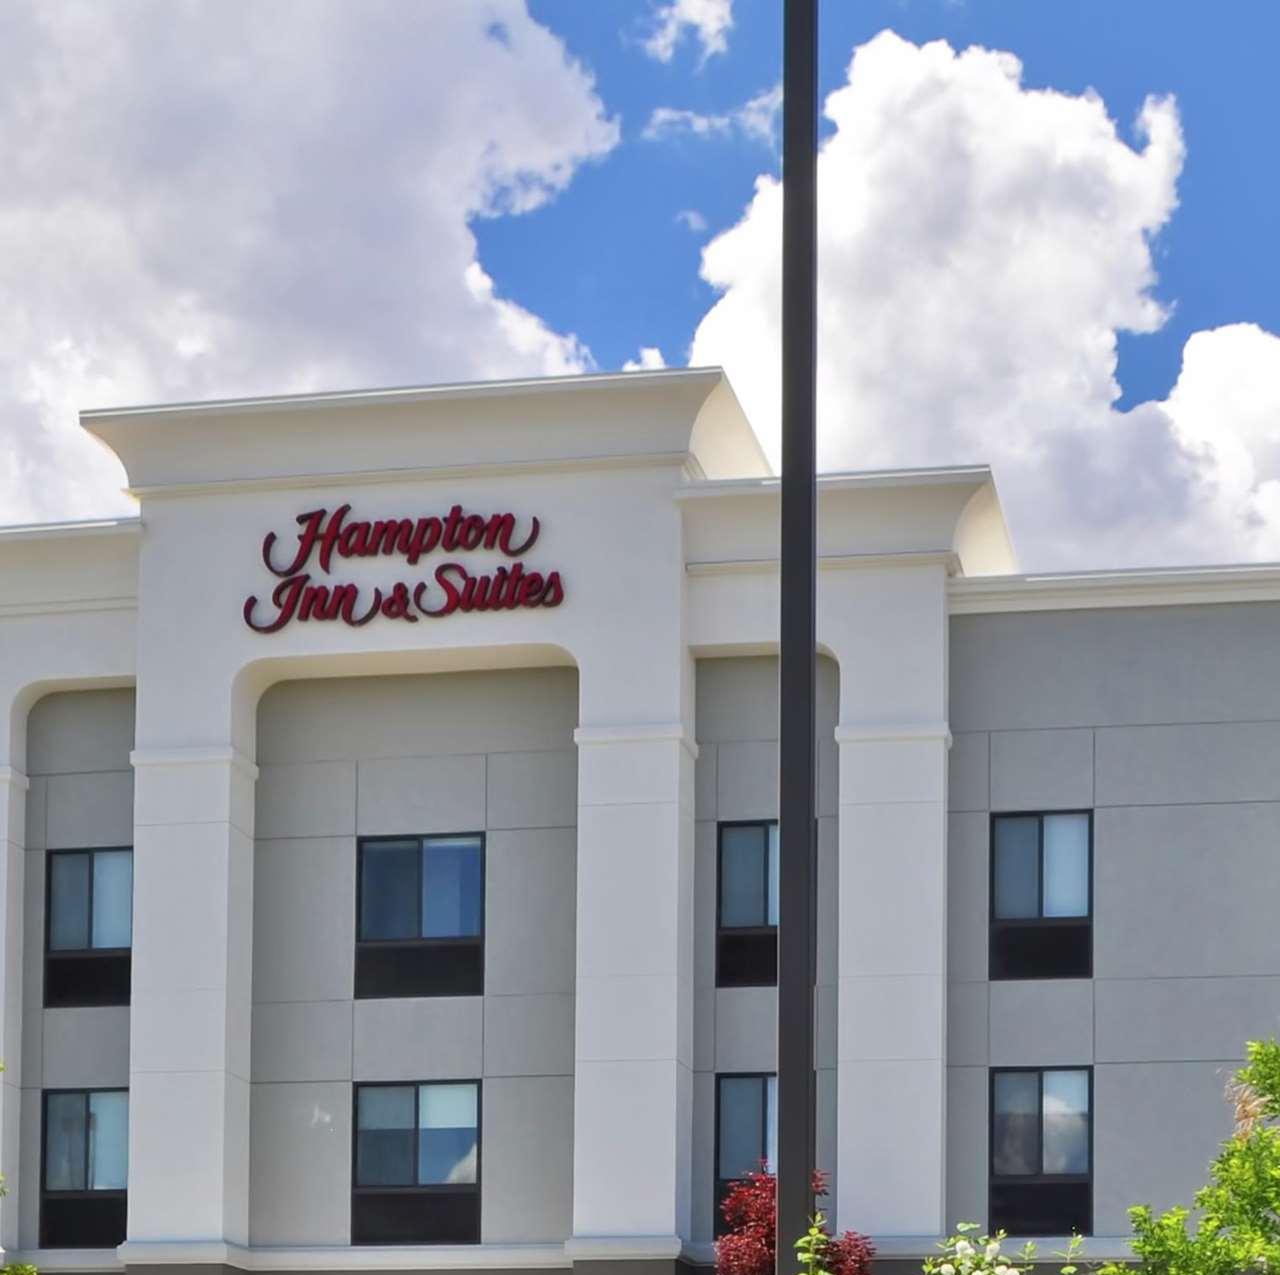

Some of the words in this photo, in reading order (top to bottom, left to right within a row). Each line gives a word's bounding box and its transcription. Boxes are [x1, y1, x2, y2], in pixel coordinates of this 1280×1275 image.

[262, 504, 540, 577] Hampton
[243, 574, 382, 634] Inn
[381, 582, 419, 623] &
[413, 562, 565, 618] Suites
